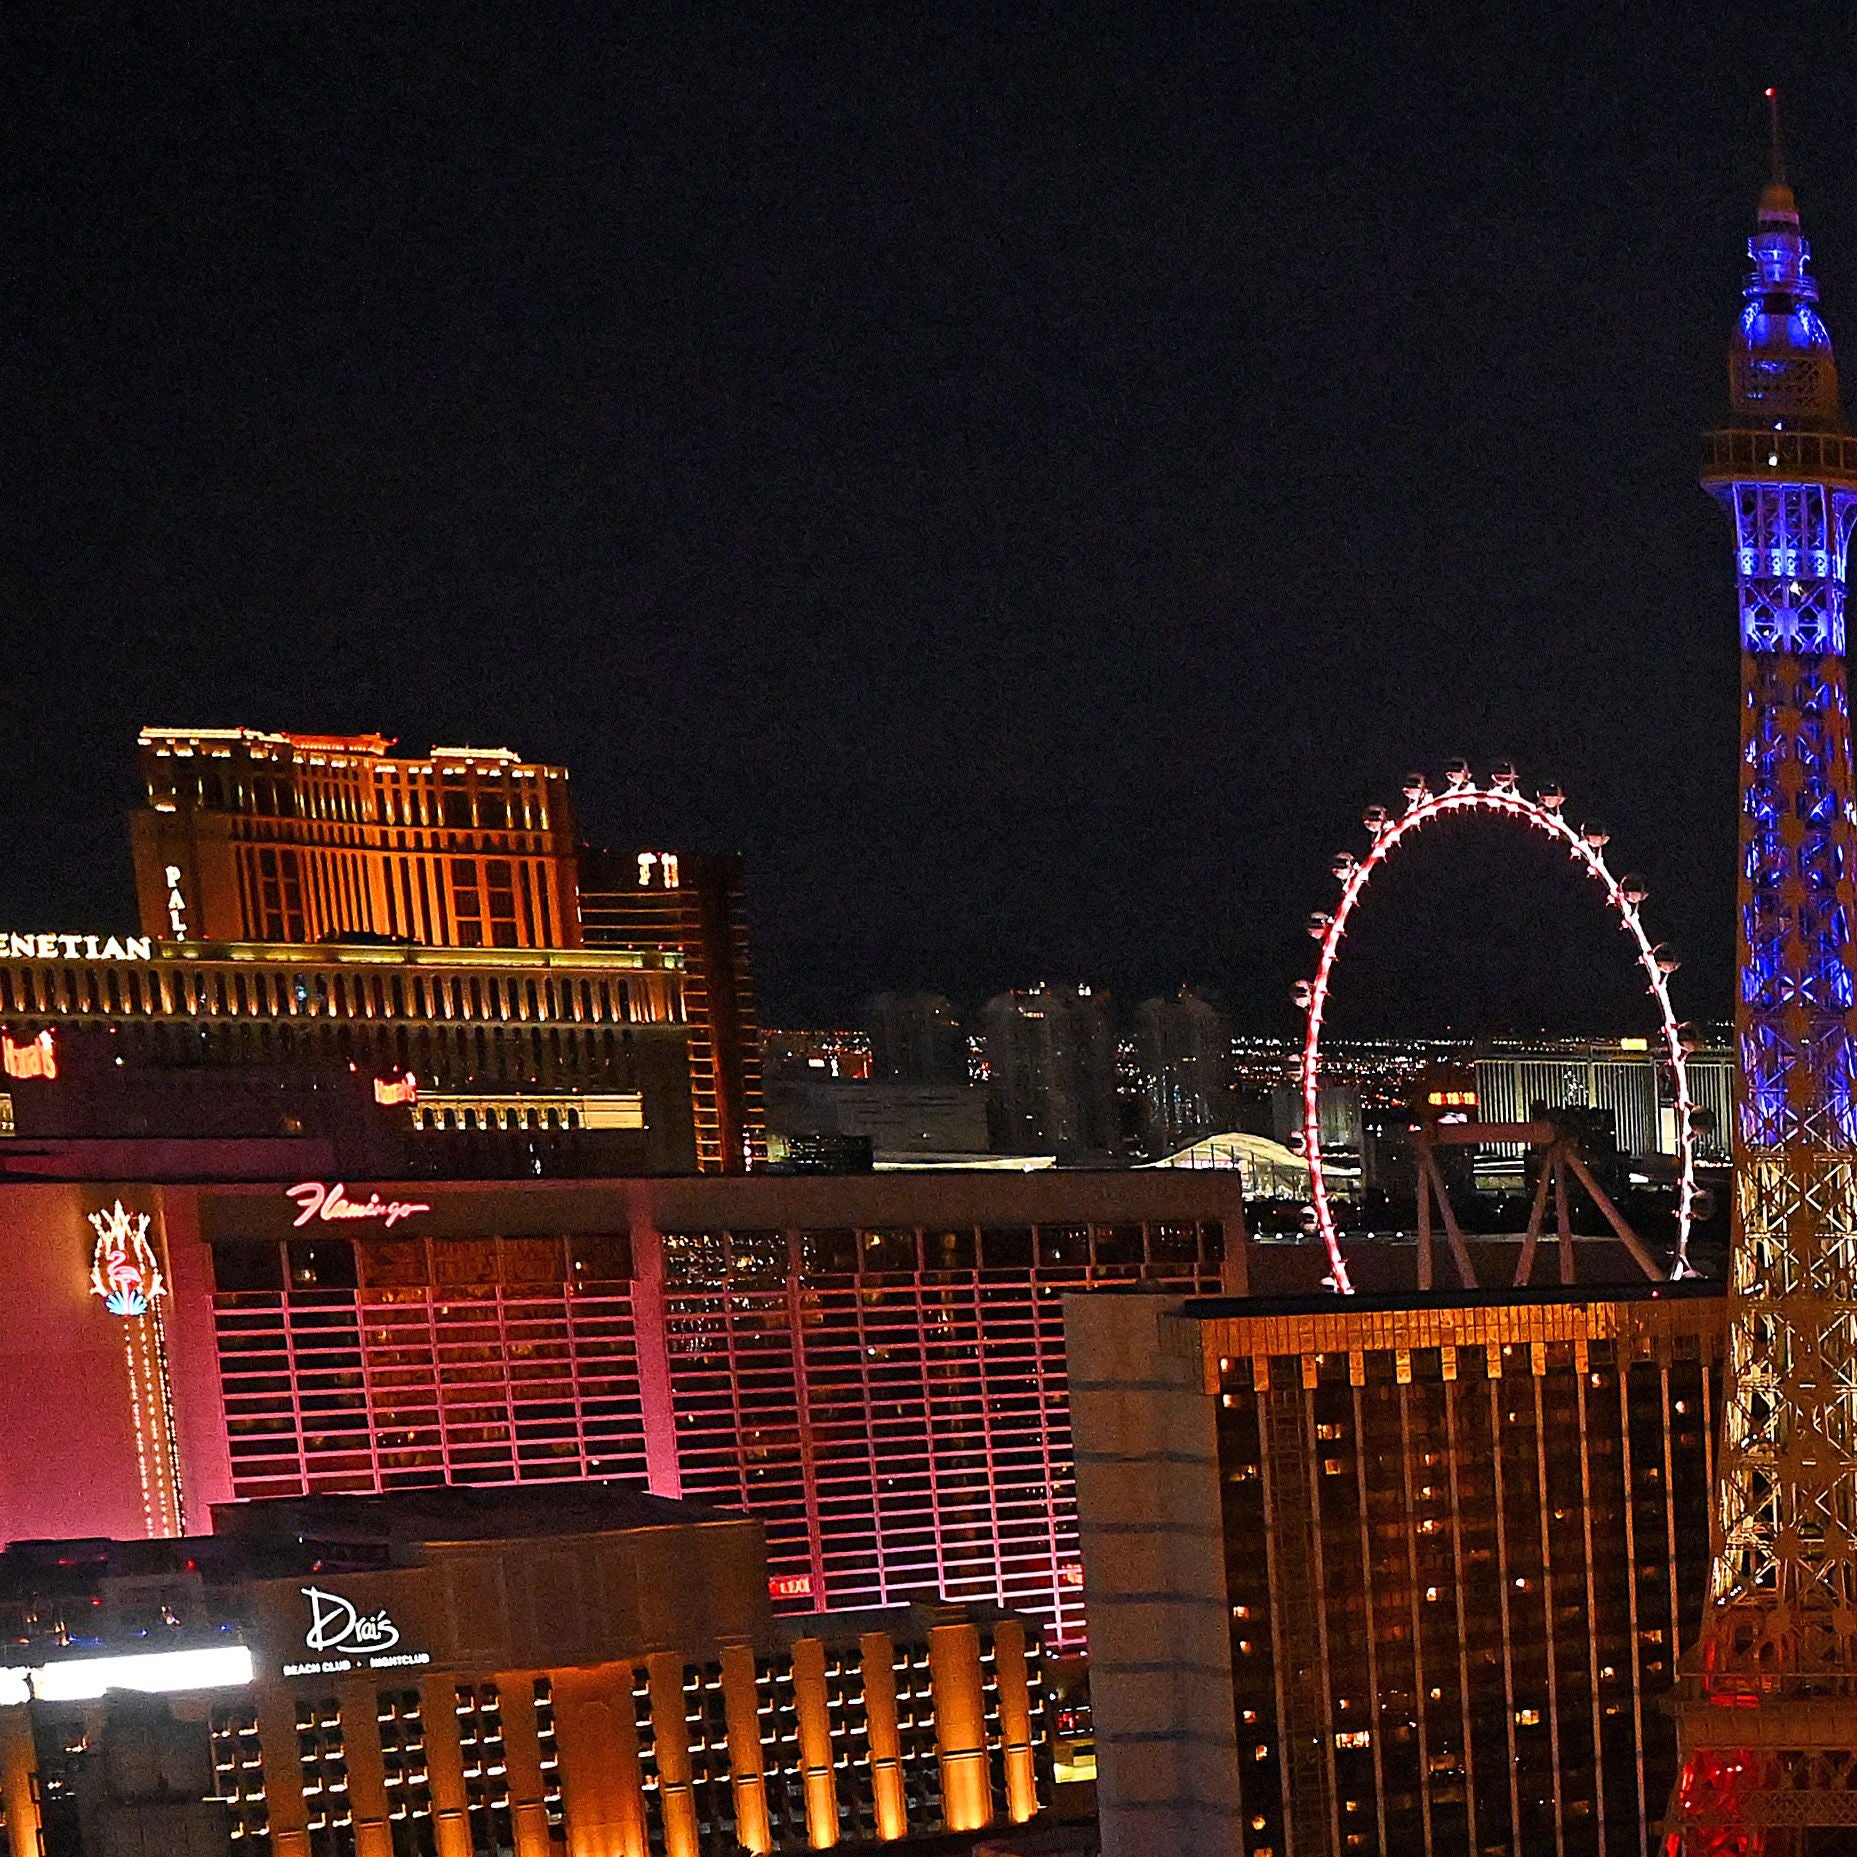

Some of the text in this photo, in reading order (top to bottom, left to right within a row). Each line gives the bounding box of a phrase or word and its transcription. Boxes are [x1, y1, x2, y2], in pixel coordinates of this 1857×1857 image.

[165, 865, 188, 941] PAL
[286, 1182, 430, 1228] Flamingo
[300, 1586, 400, 1653] Drai's
[322, 1660, 352, 1673] CLUB
